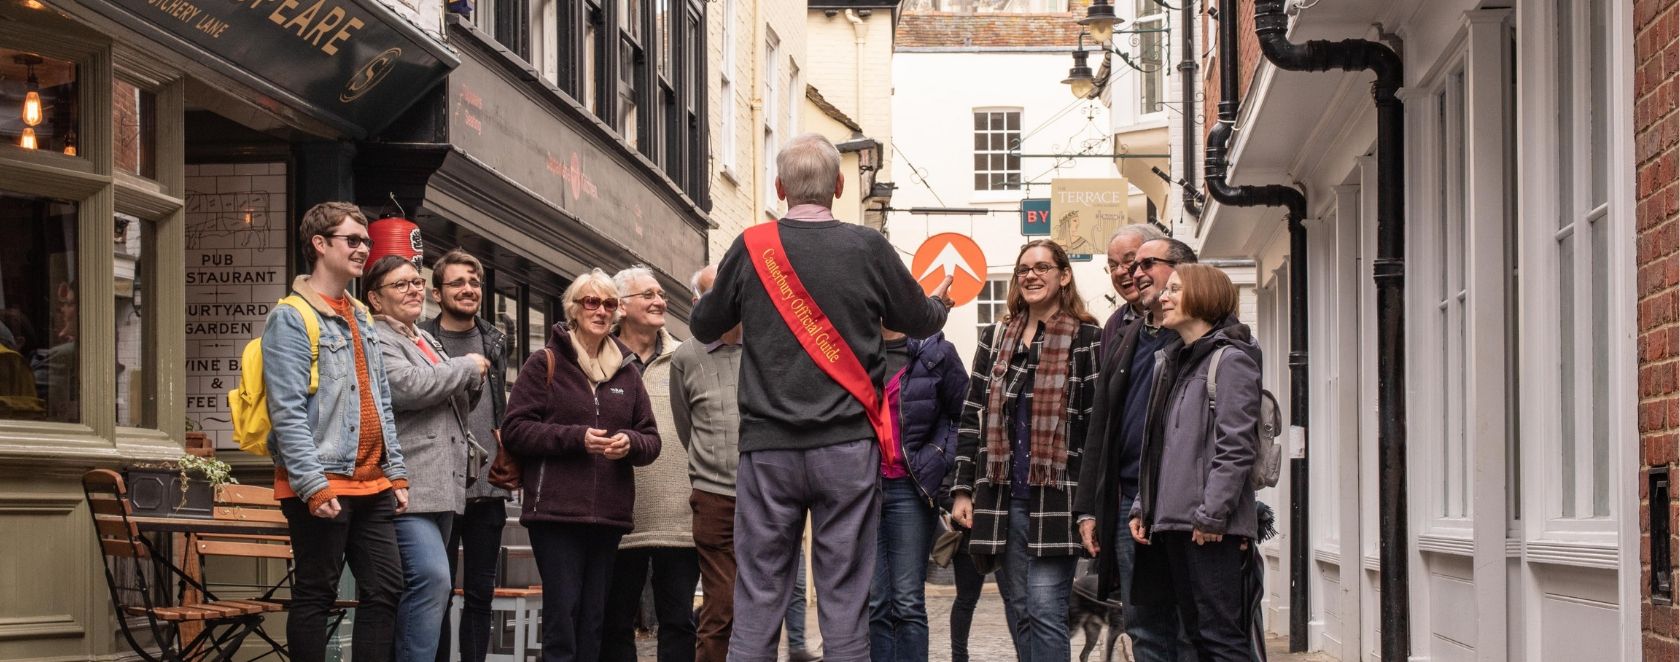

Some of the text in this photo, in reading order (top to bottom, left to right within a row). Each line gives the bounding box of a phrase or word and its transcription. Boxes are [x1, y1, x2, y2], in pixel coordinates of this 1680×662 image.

[195, 14, 230, 38] LANE
[250, 0, 365, 56] EARE
[1058, 191, 1120, 207] TERRACE
[1027, 210, 1049, 223] BY
[201, 254, 234, 266] PUB
[185, 304, 269, 316] URTYARD
[762, 248, 840, 363] Canterbury Official Guide
[185, 322, 251, 335] GARDEN
[229, 359, 243, 371] B
[211, 377, 223, 389] &
